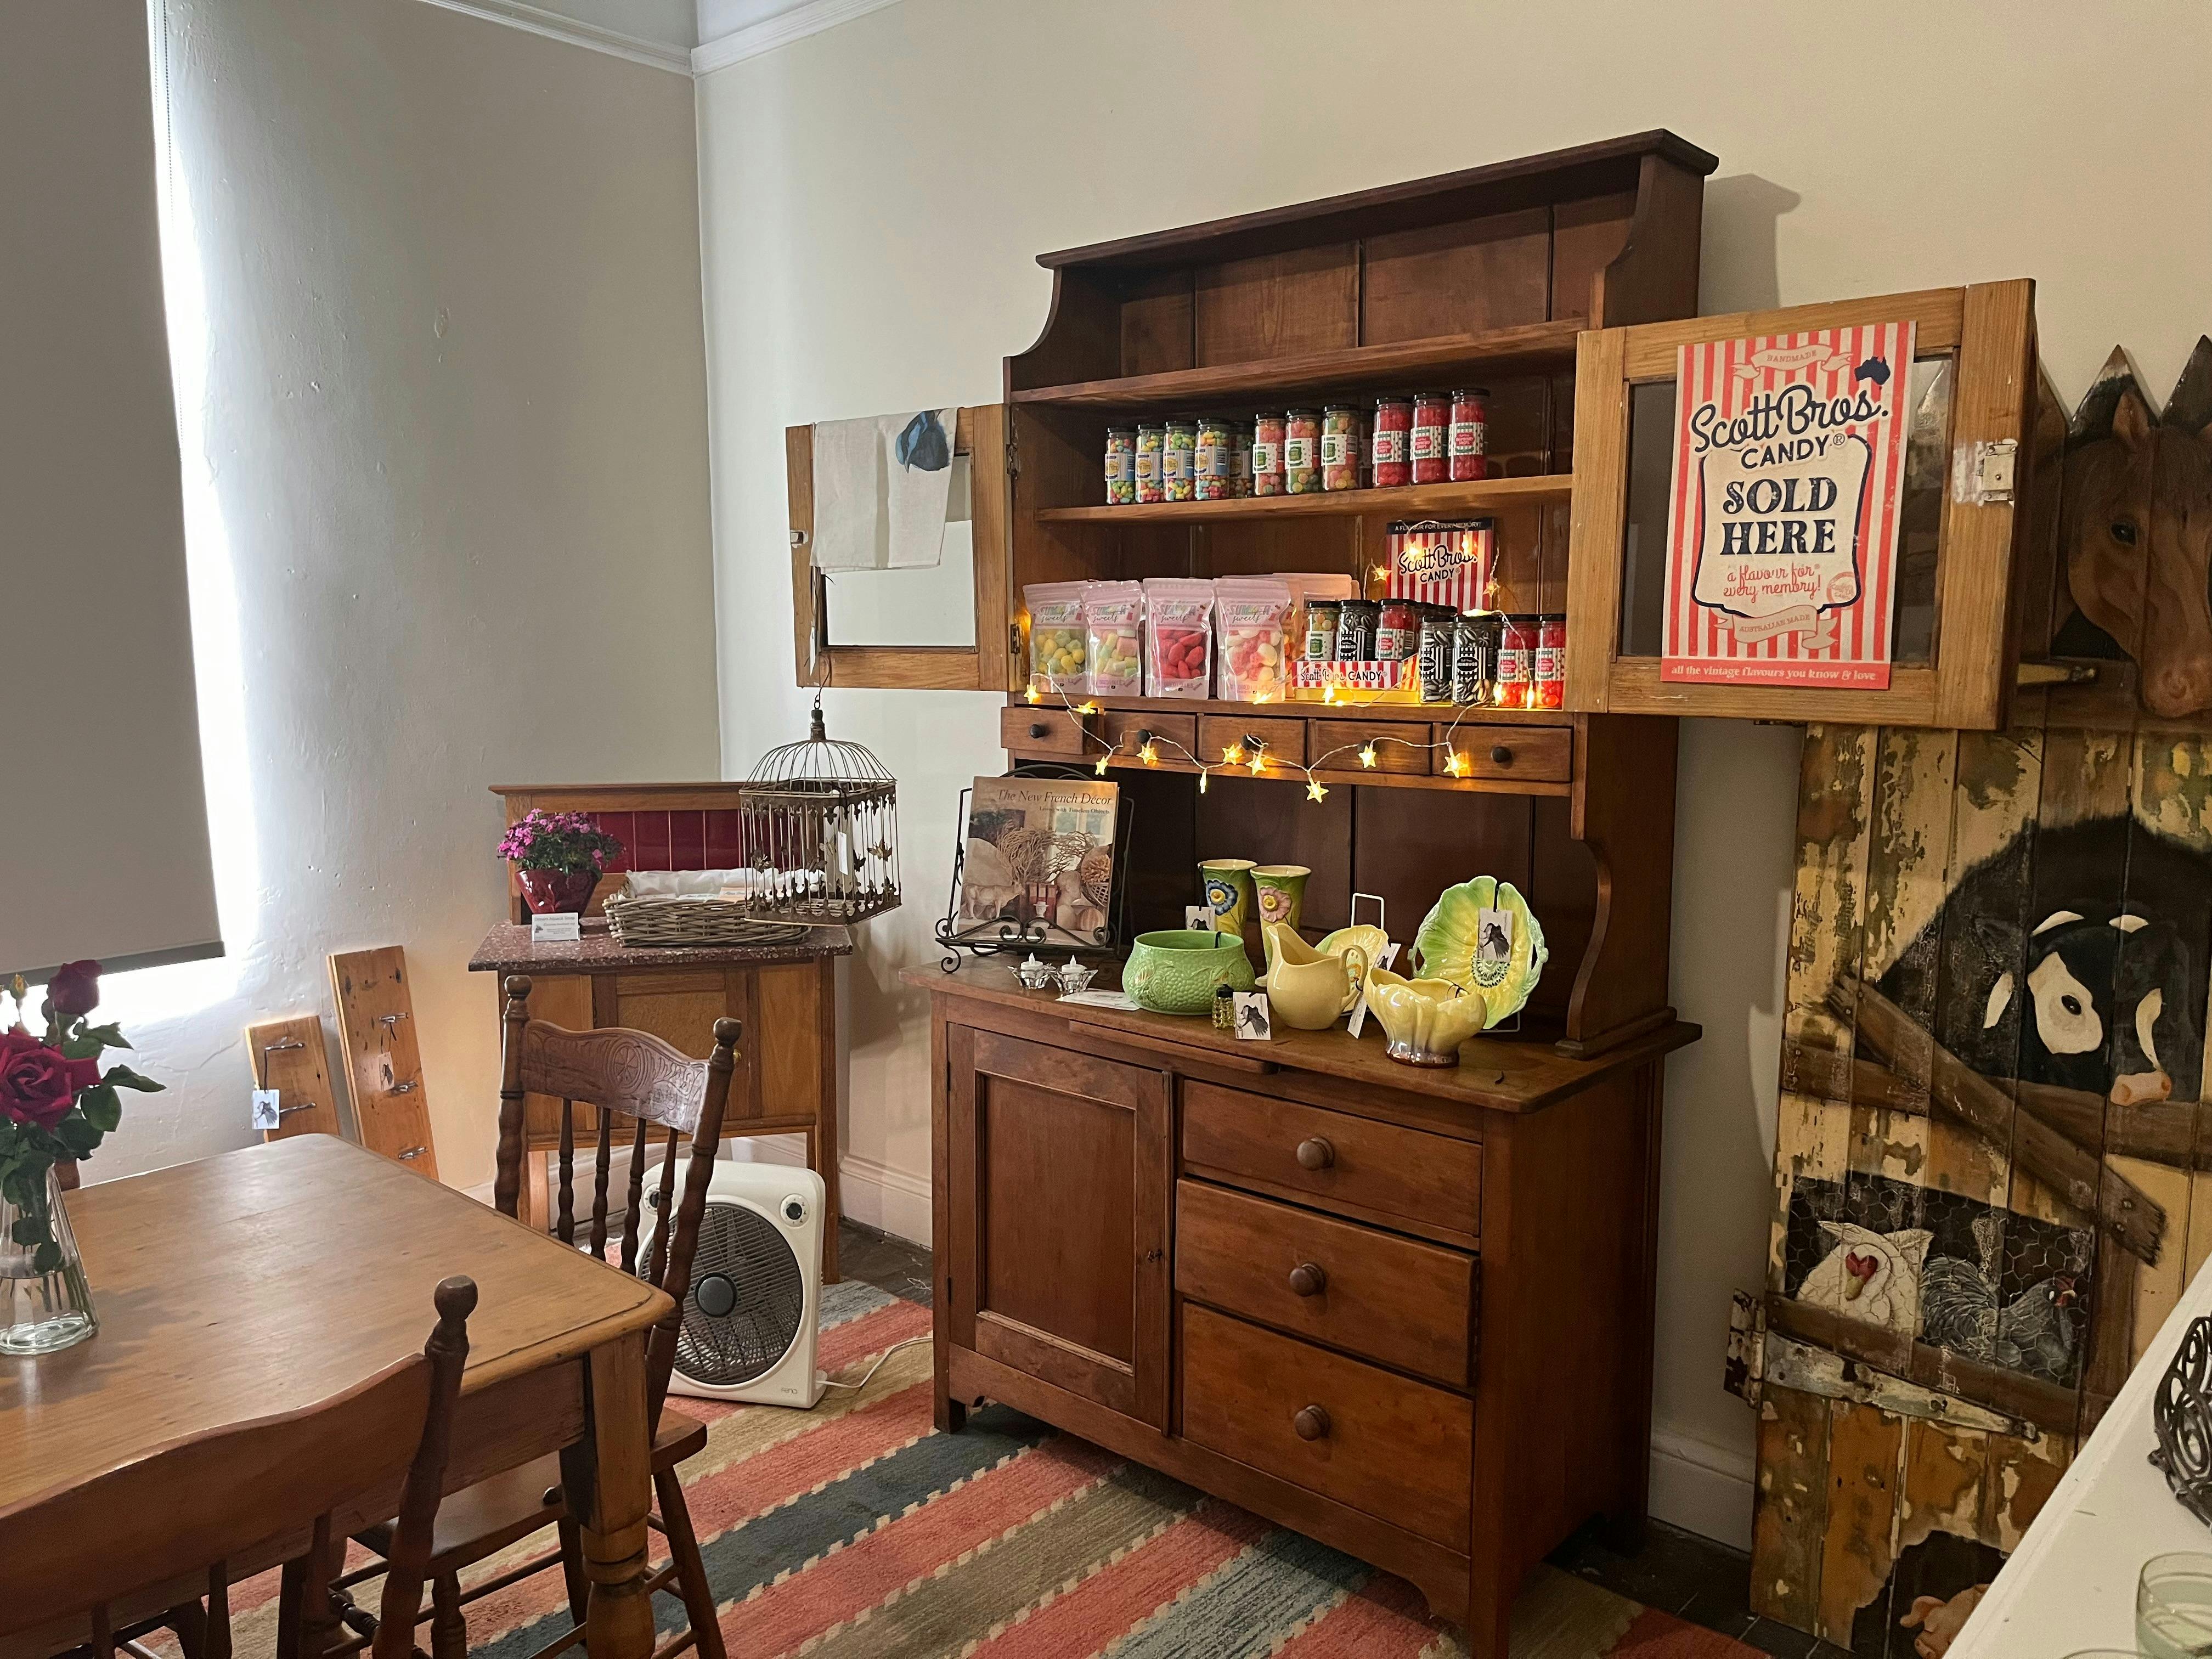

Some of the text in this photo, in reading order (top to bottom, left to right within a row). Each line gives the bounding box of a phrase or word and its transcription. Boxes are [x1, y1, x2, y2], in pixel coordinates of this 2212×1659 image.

[1767, 349, 1817, 362] HANDMADE
[1691, 384, 1889, 453] Scott Bros.
[1722, 476, 1838, 515] SOLD
[1719, 519, 1837, 555] HERE
[1398, 548, 1435, 574] Scott
[1727, 561, 1815, 589] a flavour for
[1723, 585, 1758, 603] every
[1761, 574, 1821, 600] memory!
[1739, 614, 1810, 633] AUSTRALIAN MADE
[1300, 668, 1322, 681] Scott
[1671, 665, 1876, 681] all the vintage flavours you know & love
[997, 789, 1016, 801] The
[1018, 790, 1042, 803] New
[1043, 791, 1078, 804] French
